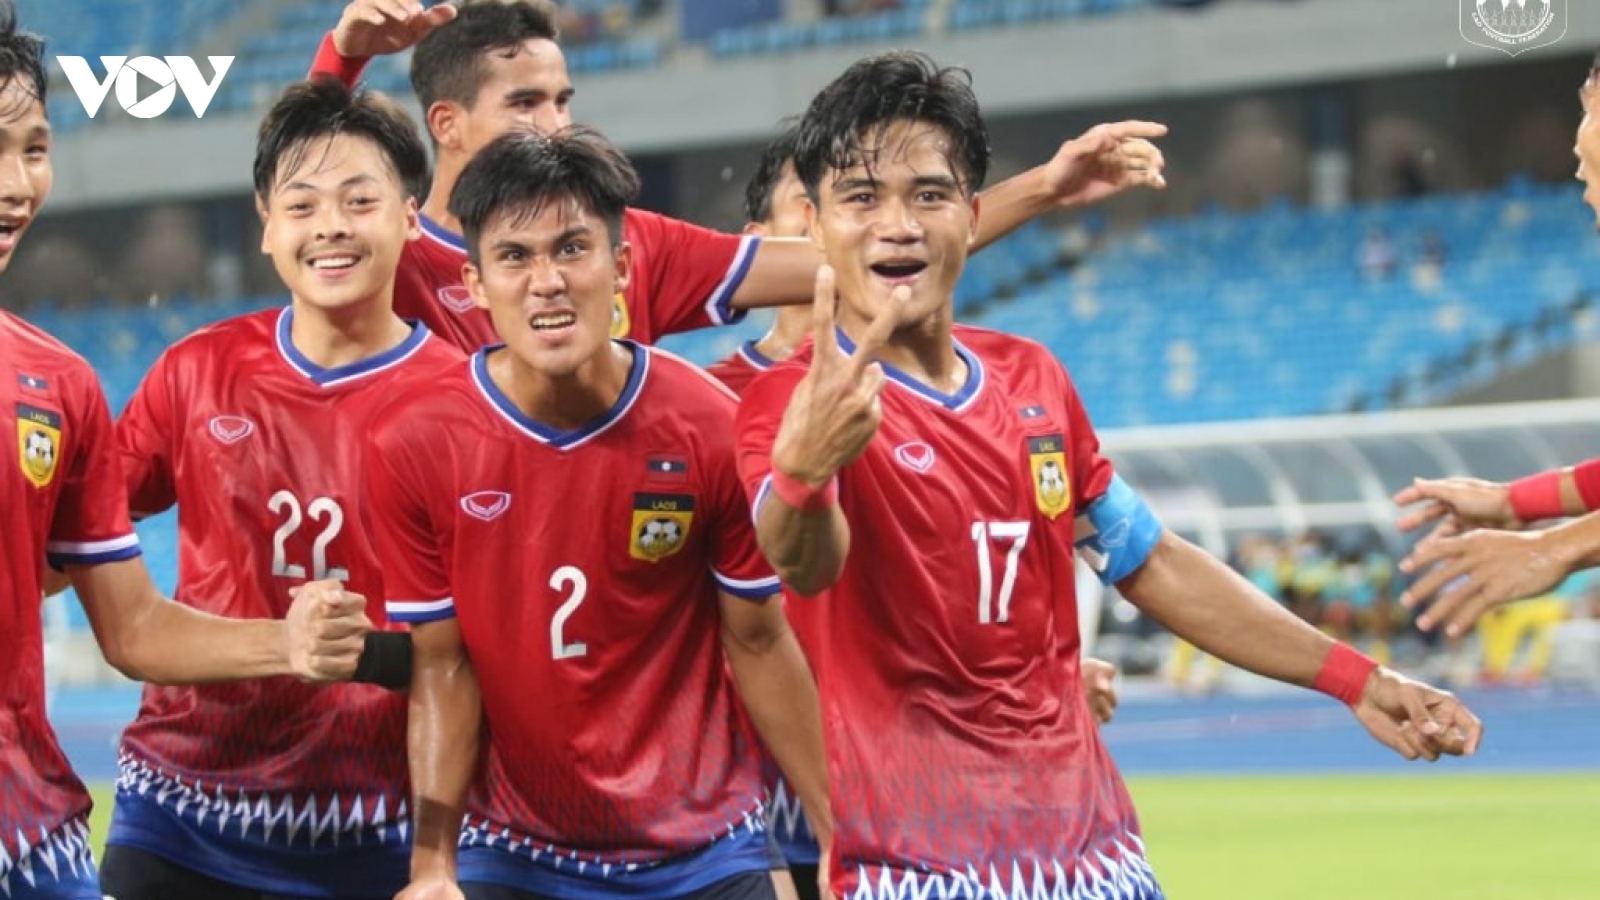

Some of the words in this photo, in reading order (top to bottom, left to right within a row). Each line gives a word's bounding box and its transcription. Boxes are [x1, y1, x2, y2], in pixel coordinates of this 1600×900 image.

[267, 489, 349, 581] 22
[971, 520, 1031, 624] 17
[549, 565, 588, 660] 2
